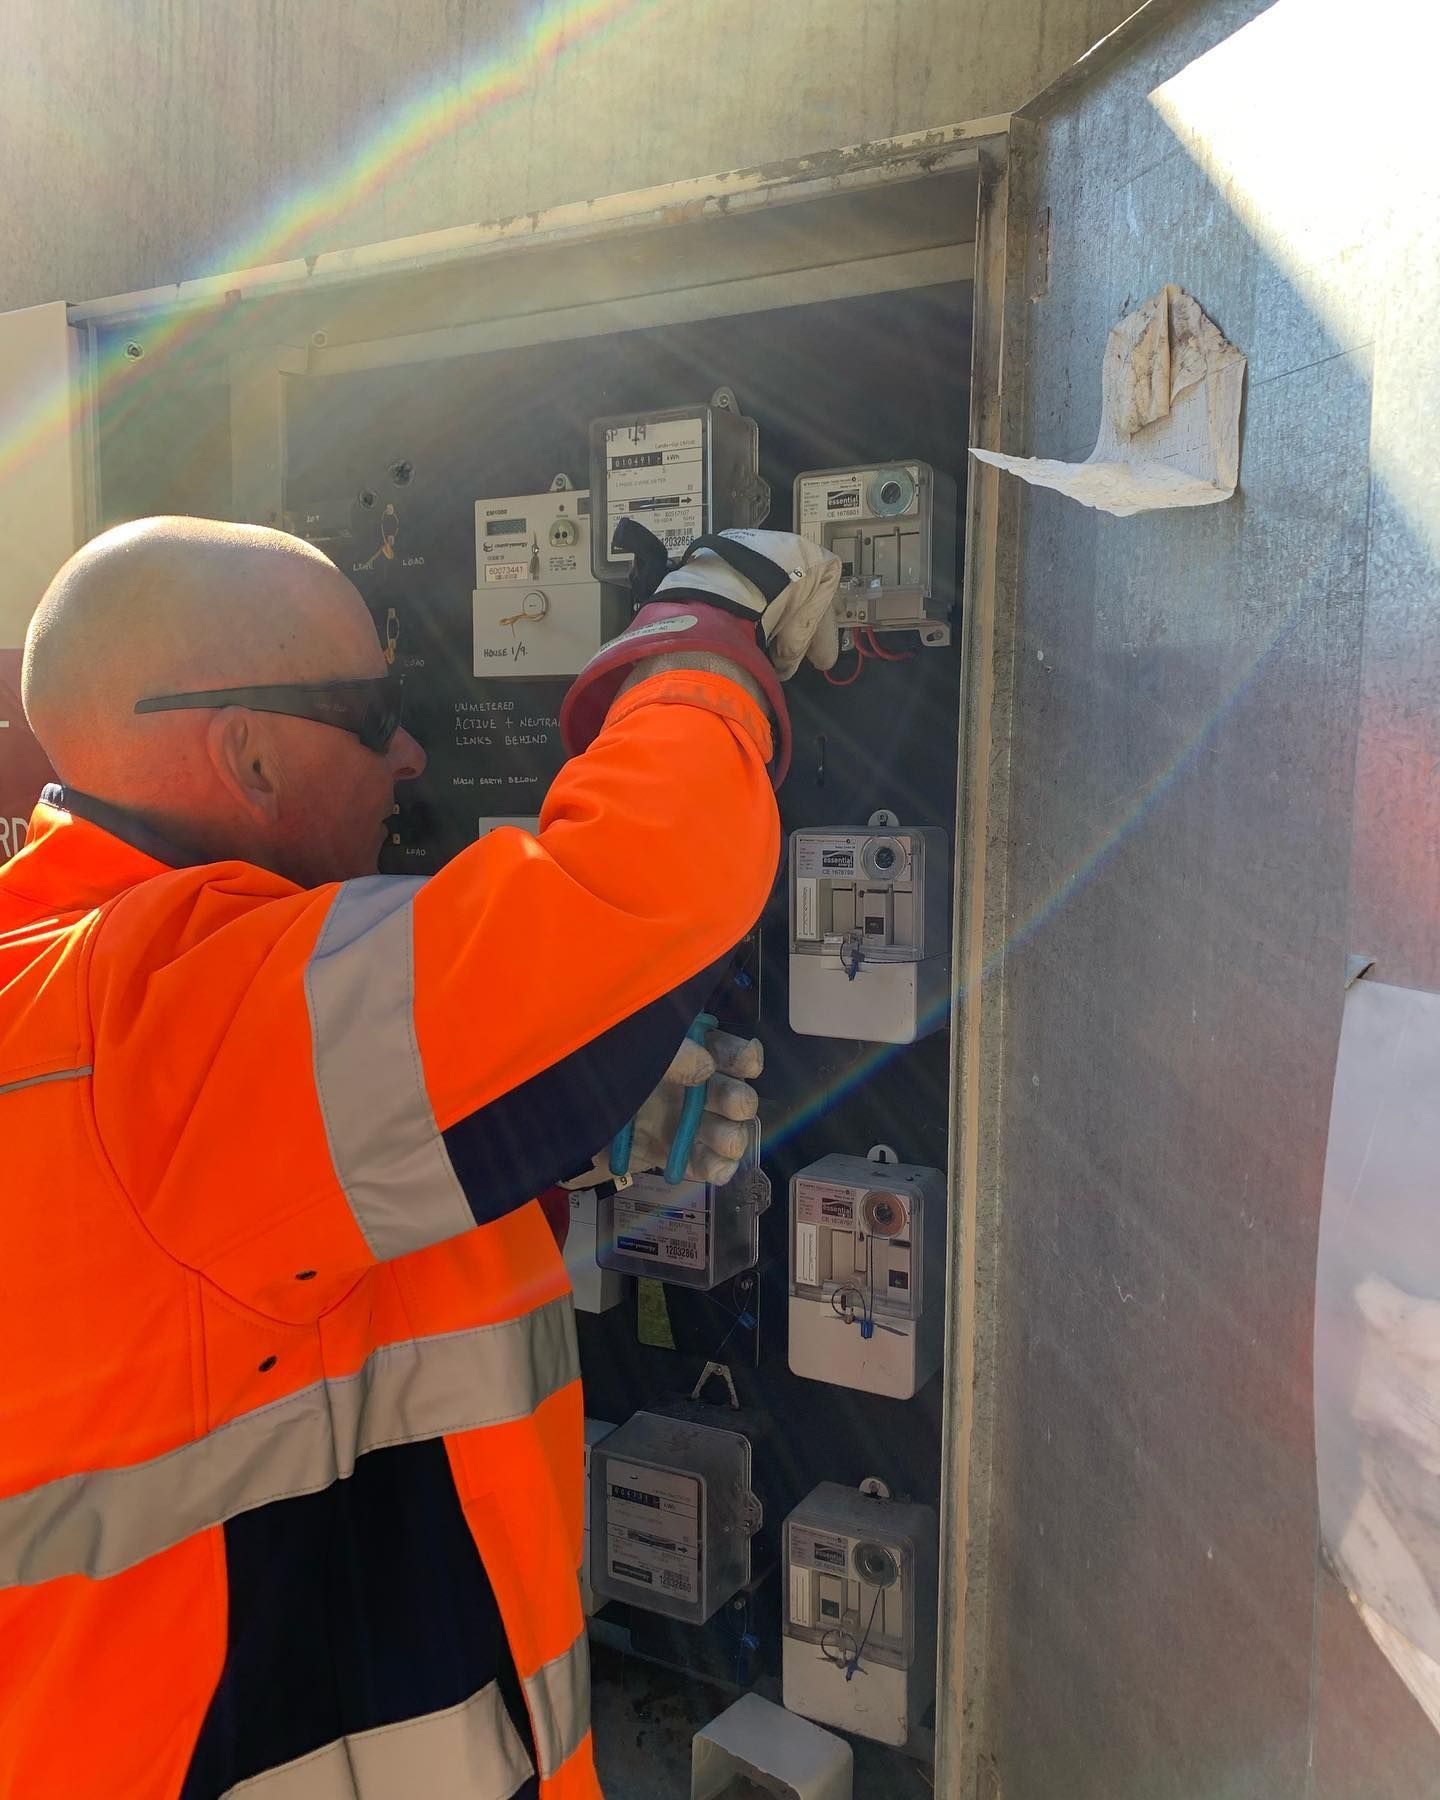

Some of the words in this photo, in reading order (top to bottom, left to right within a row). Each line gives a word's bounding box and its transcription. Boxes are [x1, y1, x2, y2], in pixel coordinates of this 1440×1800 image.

[829, 494, 859, 506] essential
[483, 648, 508, 658] HOUSE
[454, 701, 515, 712] UNMETERED
[455, 716, 497, 731] ACTIVE
[520, 715, 560, 728] NEUTRA
[455, 736, 493, 746] LINKS
[504, 734, 548, 746] BEHIND
[453, 777, 474, 785] MAIN
[479, 777, 503, 785] EARTH
[508, 776, 538, 784] BELOW
[620, 1176, 628, 1186] 9
[665, 1244, 698, 1260] 12032861
